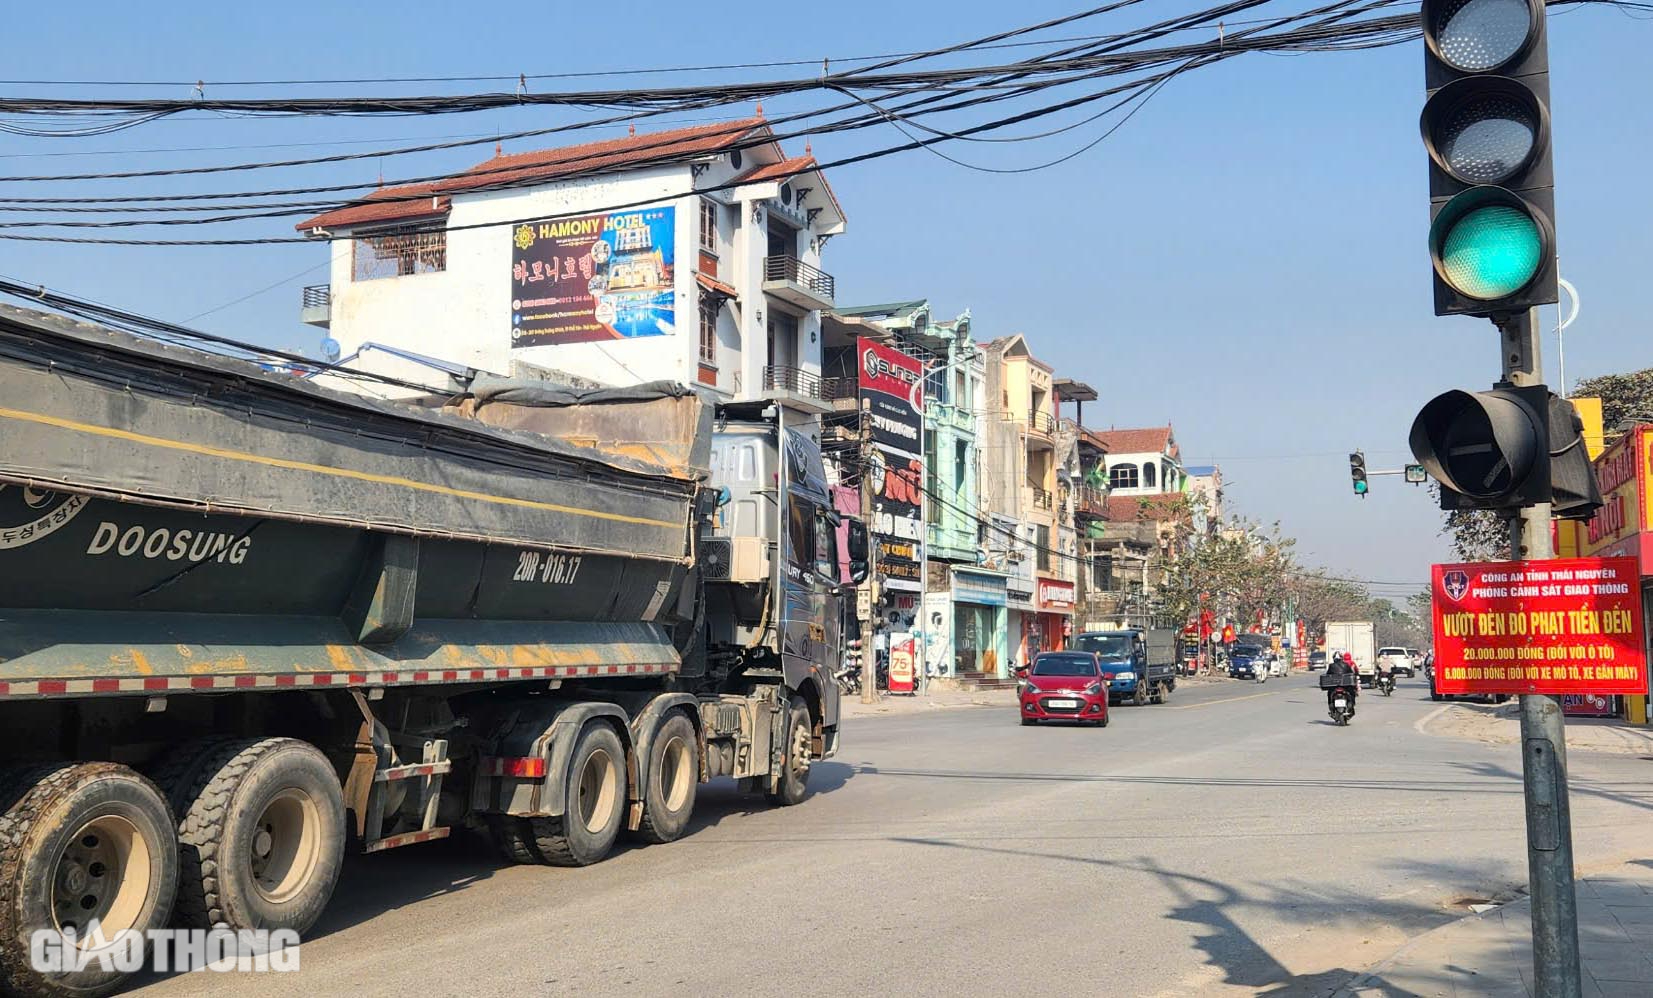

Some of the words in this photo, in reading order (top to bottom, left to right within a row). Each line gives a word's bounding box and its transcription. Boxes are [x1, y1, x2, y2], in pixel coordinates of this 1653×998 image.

[539, 218, 600, 239] HAMONY
[603, 213, 646, 232] HOTEL
[87, 521, 251, 564] DOOSUNG
[1481, 572, 1508, 583] CÔNG
[1510, 572, 1524, 582] AN
[1526, 569, 1549, 581] TỈNH
[1551, 569, 1574, 580] THÁI
[1575, 568, 1616, 579] NGUYÊN
[1472, 585, 1508, 598] PHÒNG
[1510, 583, 1539, 597] CẢNH
[1541, 584, 1563, 596] SÁT
[1564, 585, 1590, 595] GIAO
[1592, 583, 1629, 594] THÔNG
[1443, 612, 1475, 641] VƯỢT
[1478, 608, 1505, 636] ĐÈN
[1508, 602, 1527, 636] ĐỎ
[1530, 611, 1565, 640] PHẠT
[1567, 601, 1600, 635] TIỀN
[1602, 602, 1633, 635] ĐẾN
[1463, 647, 1515, 660] 20.000.000
[1587, 643, 1596, 660] Ô
[1445, 667, 1482, 680] 6.000.000
[1540, 666, 1552, 680] XE
[1553, 664, 1567, 680] MÔ
[1582, 666, 1595, 680] XE
